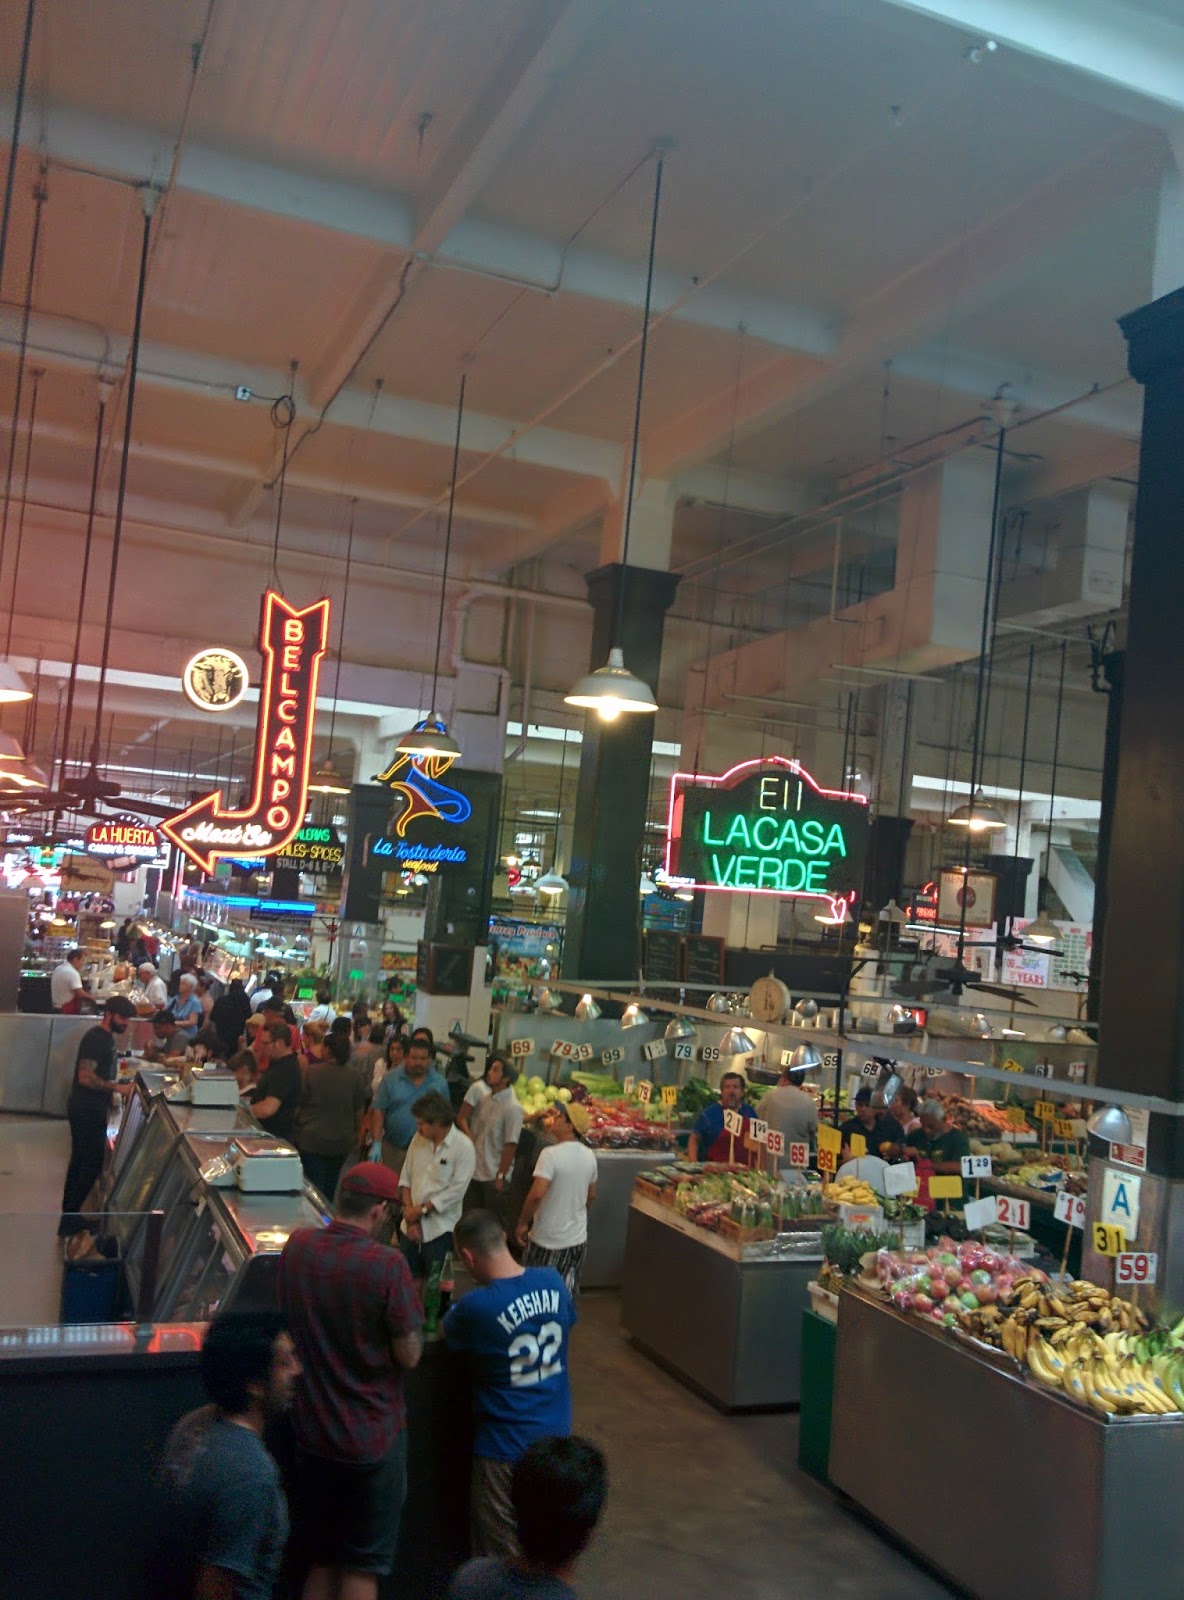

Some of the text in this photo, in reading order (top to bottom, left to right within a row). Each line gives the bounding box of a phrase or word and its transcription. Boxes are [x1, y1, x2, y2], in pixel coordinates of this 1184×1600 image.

[267, 619, 305, 830] BELCAMPO
[92, 826, 156, 845] LA HUERTA
[373, 837, 393, 855] La
[276, 857, 298, 870] STALL
[402, 859, 439, 873] seafood
[712, 853, 831, 893] VERDE
[1018, 973, 1045, 985] YEARS
[512, 1041, 531, 1054] 69
[553, 1040, 573, 1056] 79
[603, 1049, 621, 1062] 99
[677, 1045, 692, 1058] 79
[767, 1132, 781, 1151] 69
[1111, 1183, 1131, 1217] A
[496, 1289, 560, 1335] KERSHAW
[508, 1320, 563, 1388] 22
